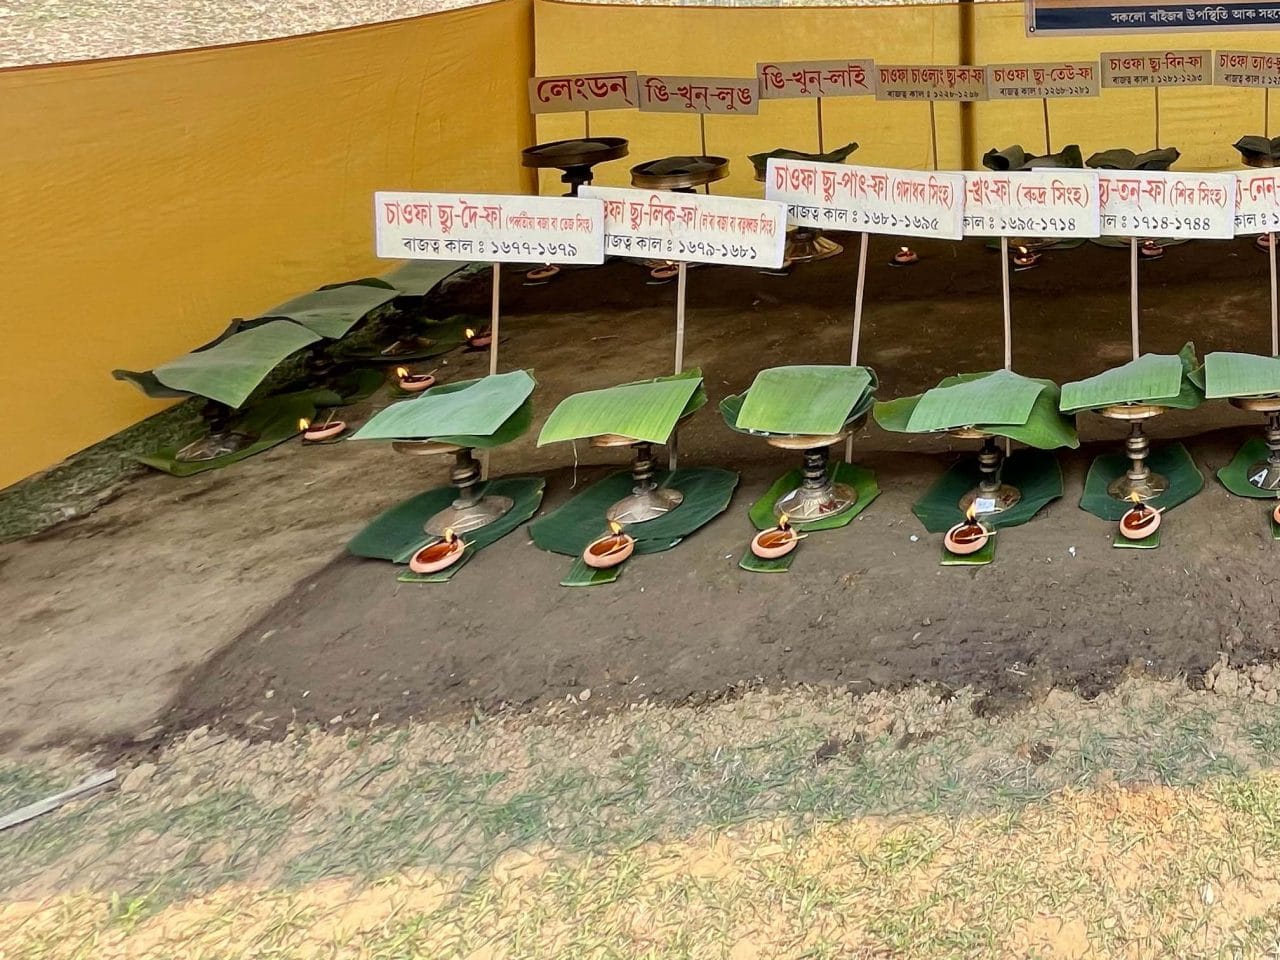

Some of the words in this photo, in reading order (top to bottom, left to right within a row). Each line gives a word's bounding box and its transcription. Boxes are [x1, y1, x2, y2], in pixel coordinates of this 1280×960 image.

[1111, 12, 1146, 23] সকলো
[1150, 9, 1183, 22] ৰাইজৰ
[1186, 7, 1228, 23] উপস্থিতি
[1232, 9, 1257, 21] আৰু
[1110, 57, 1144, 71] চাওফা
[1220, 54, 1248, 69] চাওফা
[880, 68, 908, 83] চাওফা
[994, 68, 1028, 82] চাওফা
[537, 76, 633, 105] লেংডন্
[774, 162, 817, 194] চাওফা
[1051, 179, 1089, 208] সিংহ)
[1198, 181, 1227, 208] সিংহ)
[385, 200, 432, 231] চাওফা
[788, 205, 819, 222] ৰাজত্ব
[824, 208, 848, 222] কাল
[864, 211, 939, 231] ১৬৮১-১৬৯৫
[1001, 218, 1075, 231] ১৬৯৫-১৭১৪
[1134, 216, 1210, 231] ১৭১৪-১৭৪৪
[402, 237, 440, 253] ৰাজত্ব
[445, 238, 472, 254] কাল
[492, 240, 577, 257] ১৬৭৭-১৬৭৯
[636, 236, 662, 252] কাল
[679, 242, 757, 259] ১৬৭৯-১৬৮১
